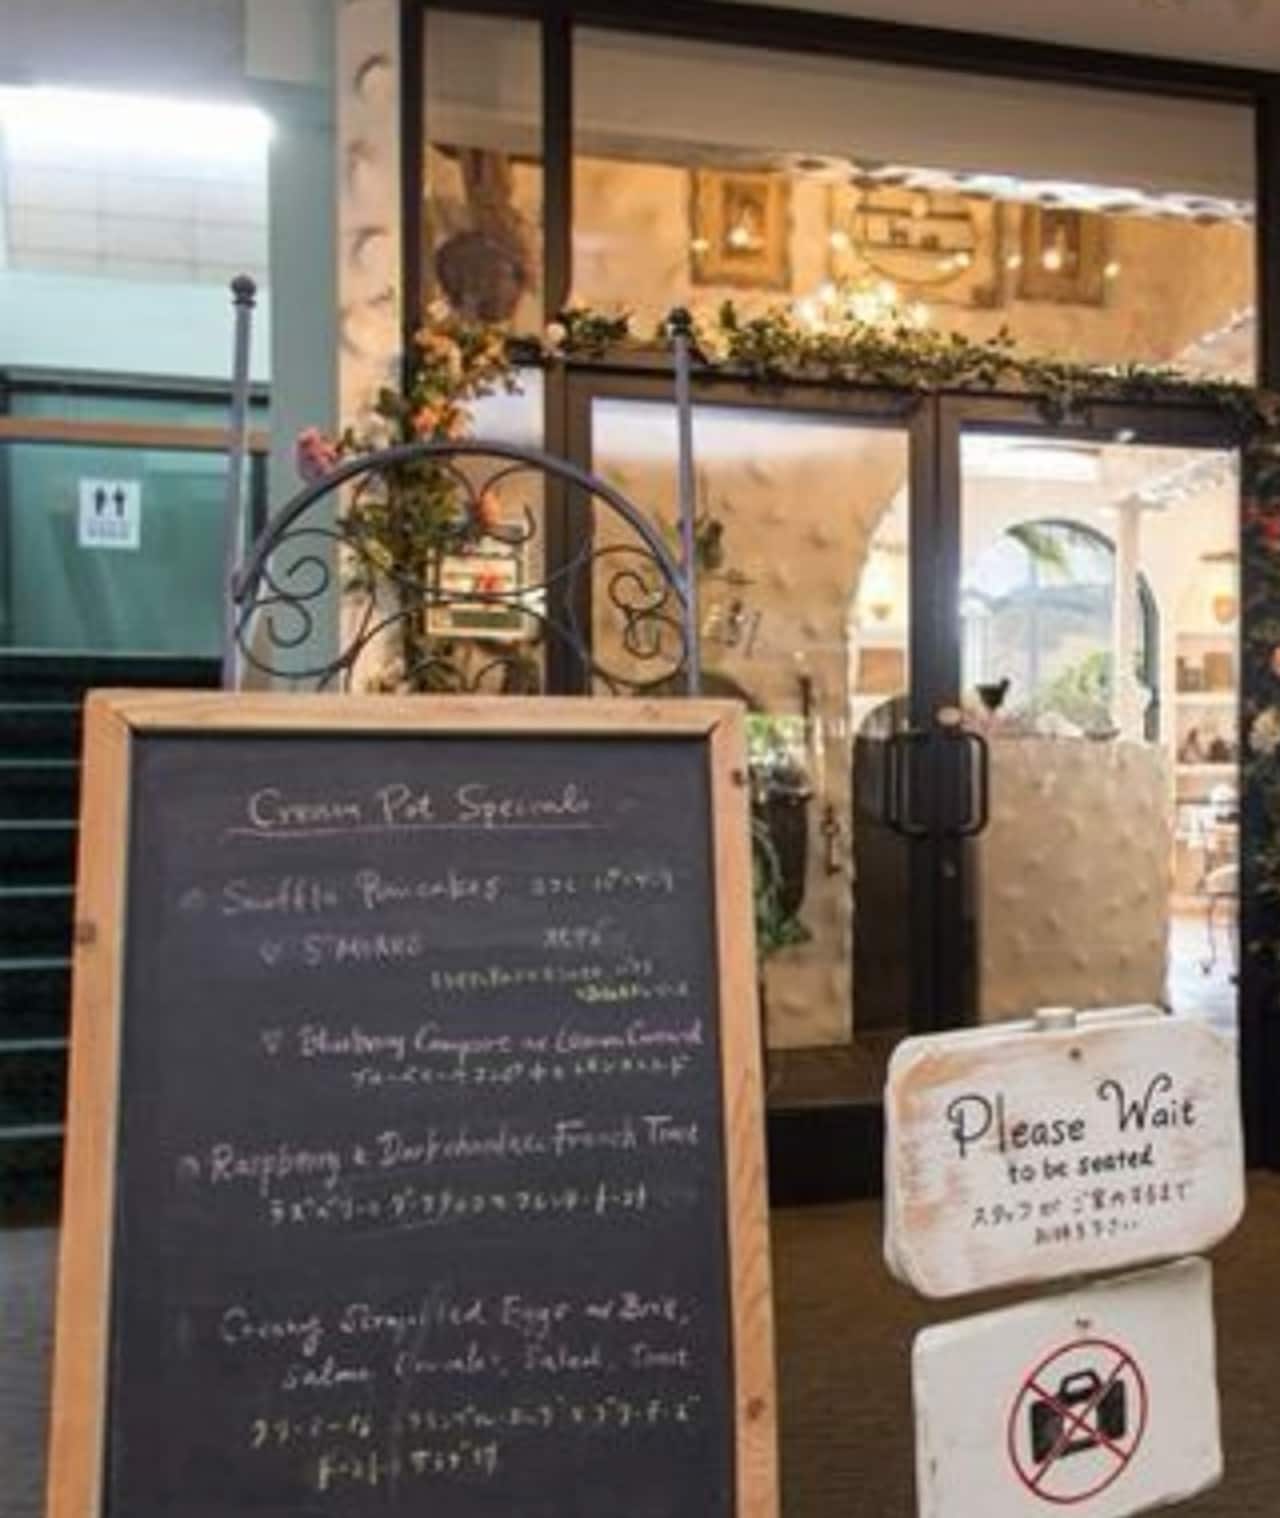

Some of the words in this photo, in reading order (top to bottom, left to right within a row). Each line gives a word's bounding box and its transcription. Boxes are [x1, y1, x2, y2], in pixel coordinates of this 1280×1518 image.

[248, 785, 364, 830] Cream
[380, 781, 434, 821] Pot
[946, 1091, 1086, 1158] Please
[1096, 1072, 1198, 1133] Wait
[1008, 1162, 1034, 1186] to
[1042, 1157, 1070, 1181] be
[1078, 1143, 1154, 1176] seated
